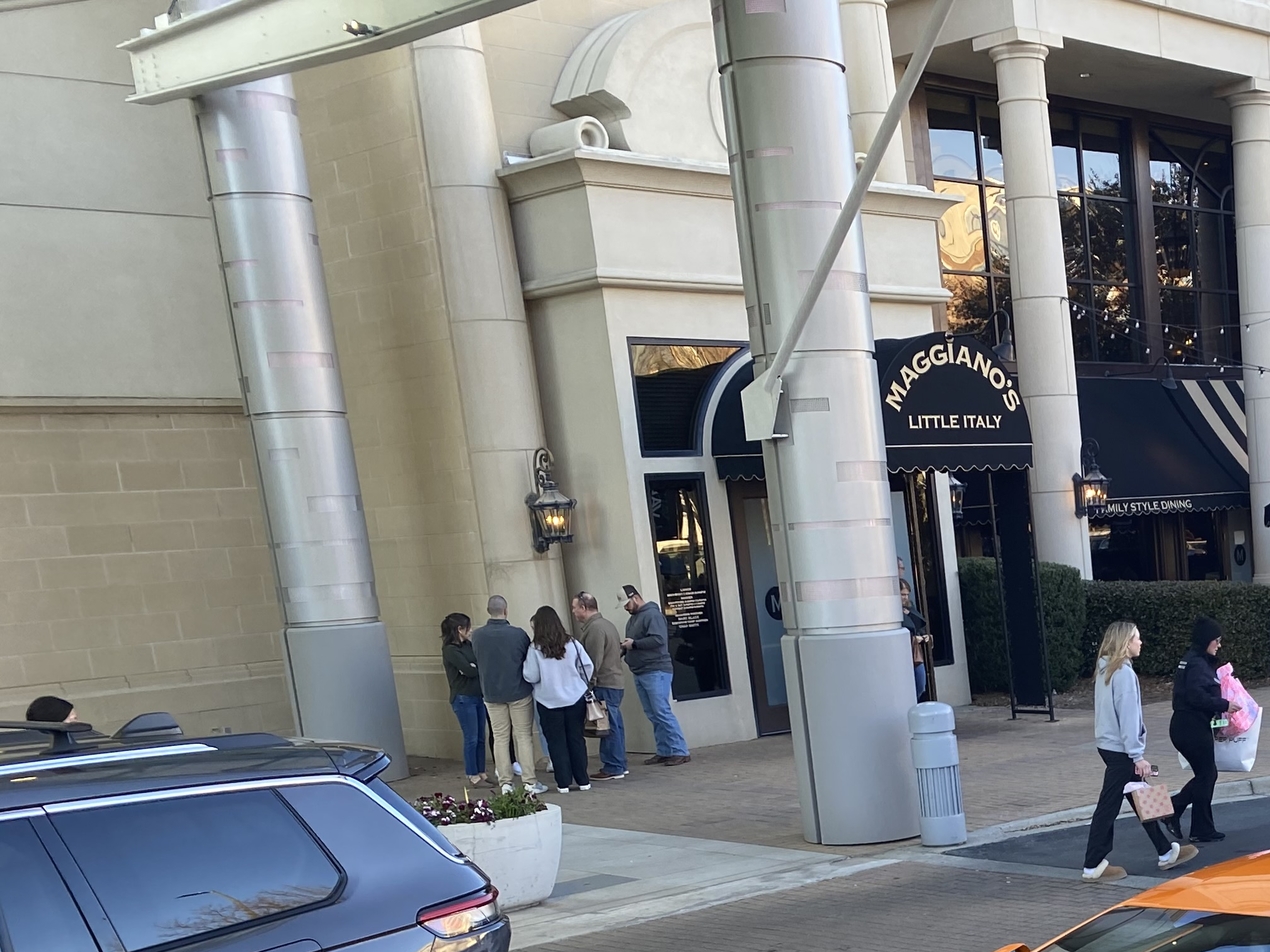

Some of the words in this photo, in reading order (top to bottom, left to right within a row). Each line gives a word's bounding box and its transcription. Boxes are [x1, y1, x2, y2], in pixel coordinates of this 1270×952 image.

[885, 341, 1021, 412] MAGGIANO'S
[908, 414, 960, 430] LITTLE
[963, 414, 1002, 429] ITALY
[1130, 501, 1159, 512] STYLE
[1161, 499, 1193, 510] DINING
